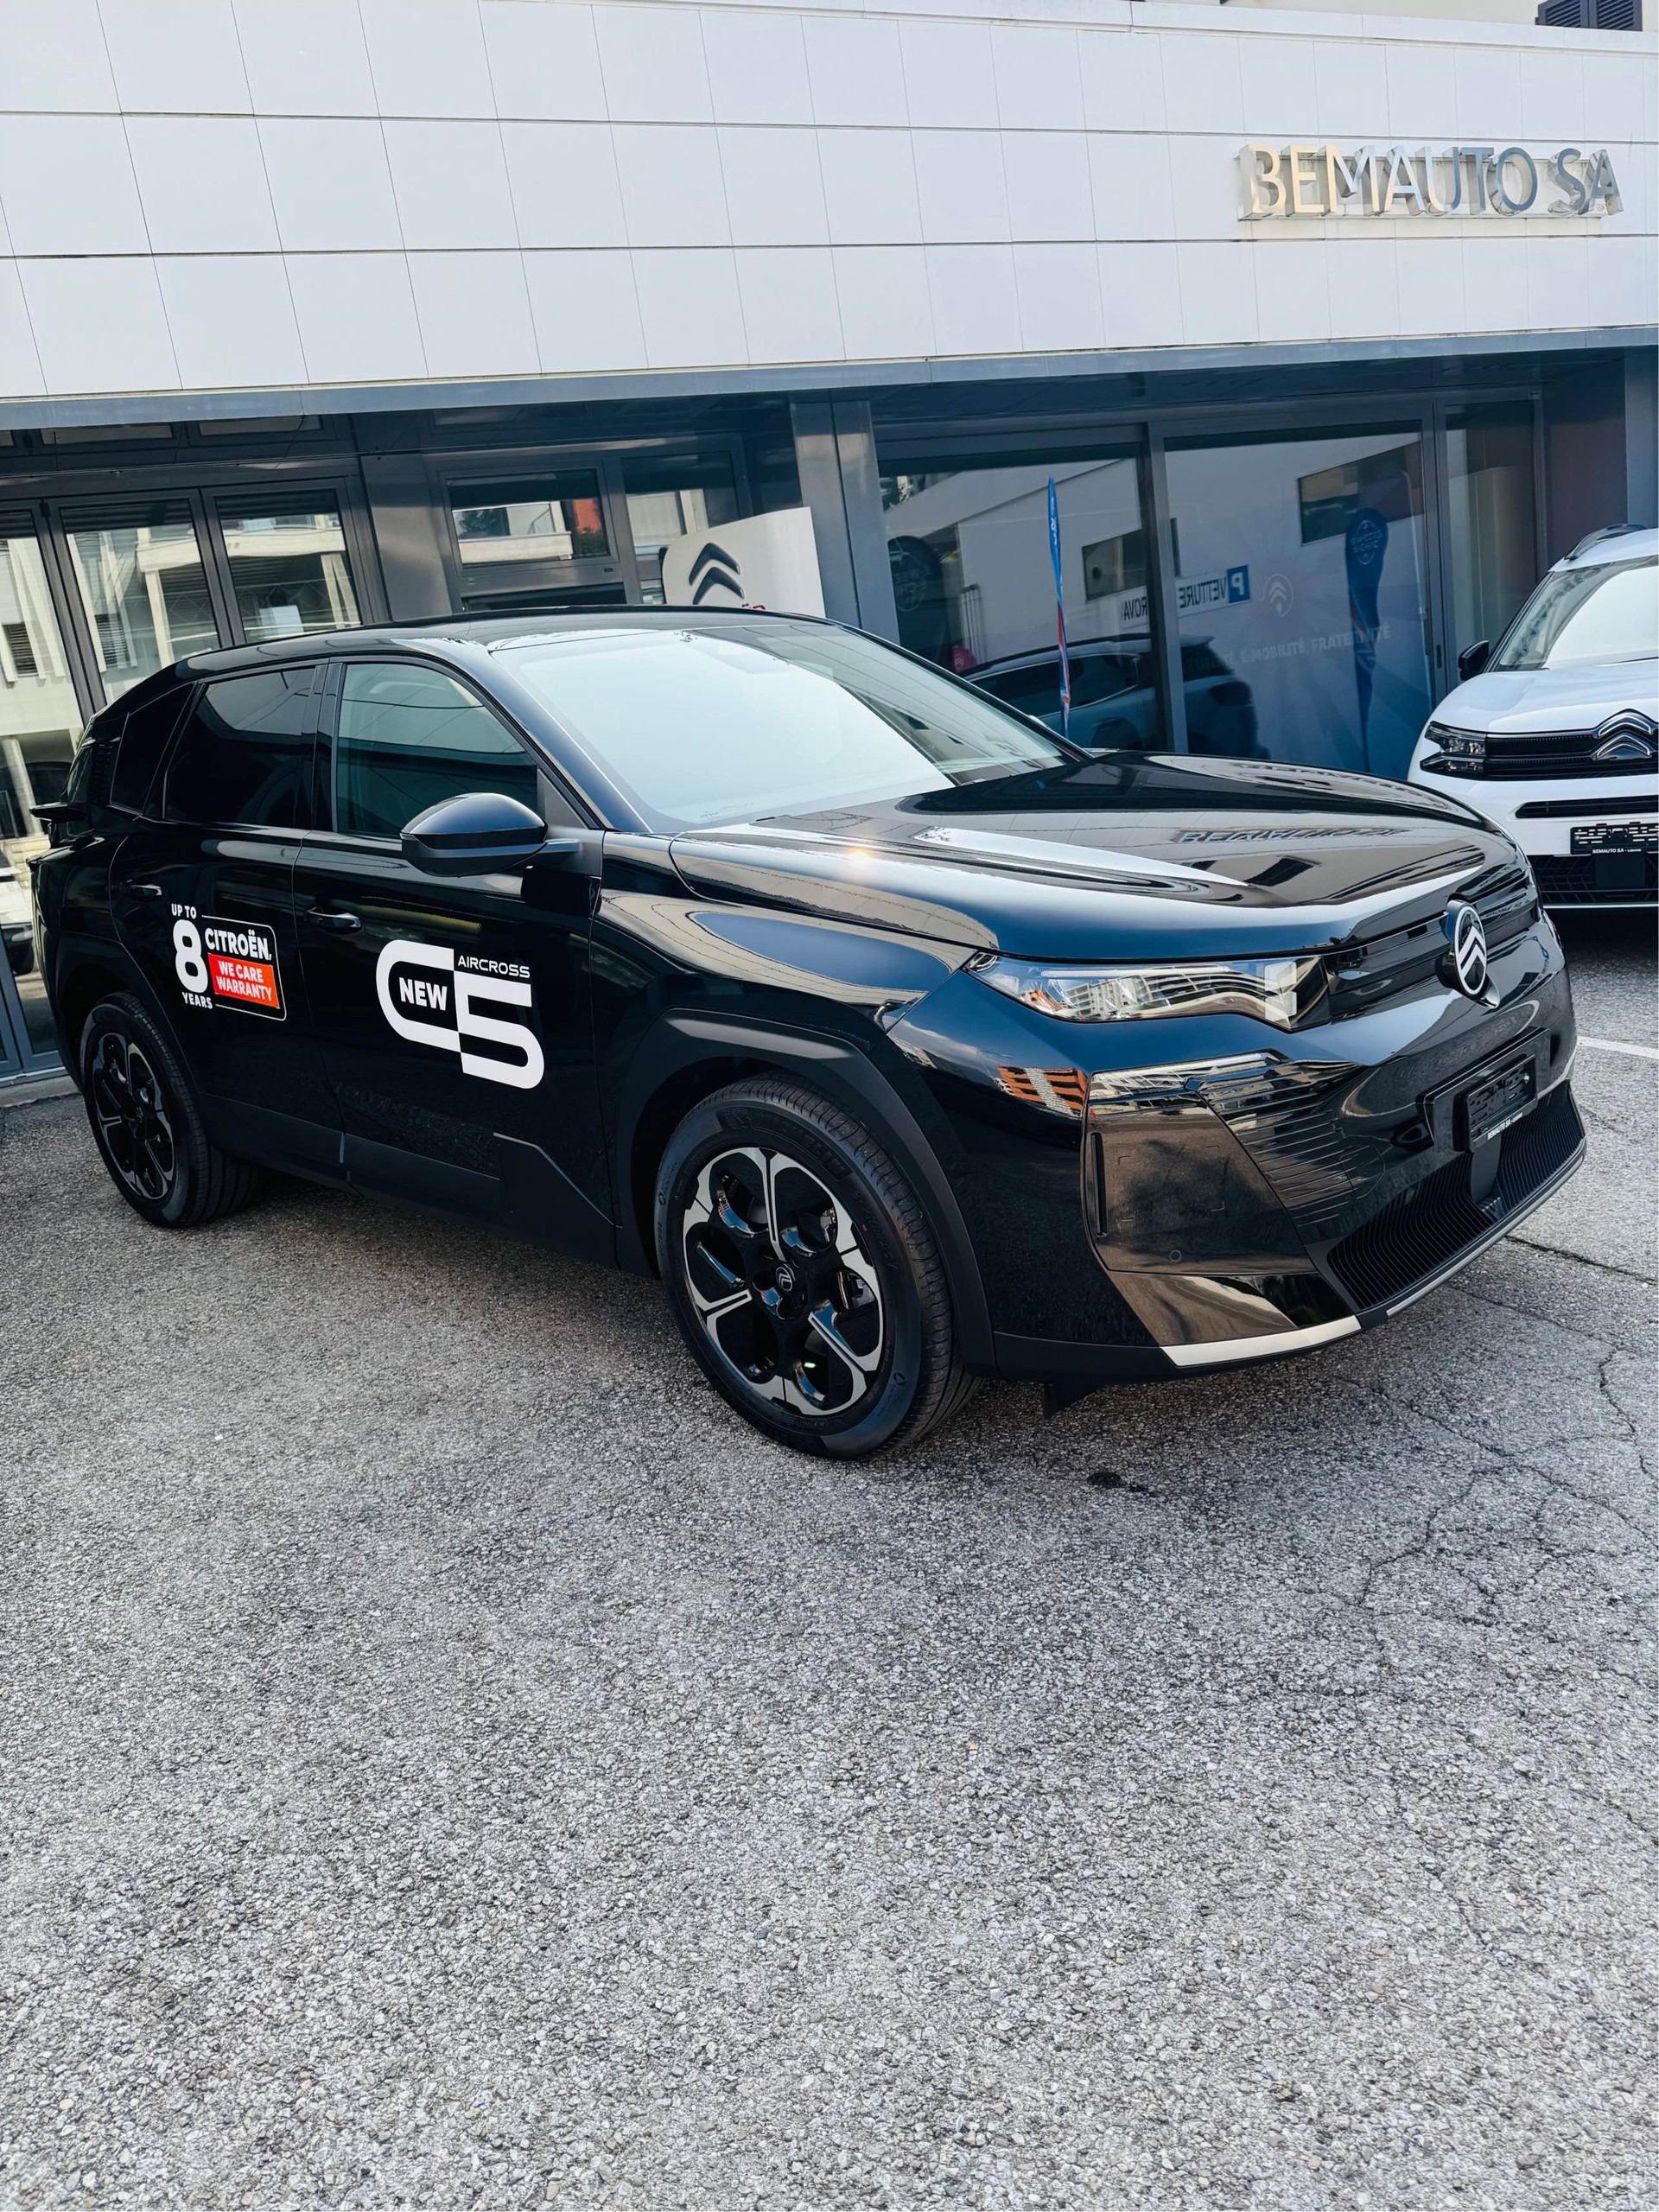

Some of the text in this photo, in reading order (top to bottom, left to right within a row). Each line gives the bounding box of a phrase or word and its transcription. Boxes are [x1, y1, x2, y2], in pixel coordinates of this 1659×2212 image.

[1242, 144, 1624, 216] BEMAUTO SA
[171, 903, 197, 919] UP TO
[173, 918, 208, 994] 8
[457, 955, 531, 979] AIRCROSS
[218, 960, 264, 983] WE CARE
[181, 991, 213, 1010] YEARS
[215, 976, 272, 1002] WARRANTY
[398, 976, 448, 1011] NEW
[376, 939, 544, 1089] C5
